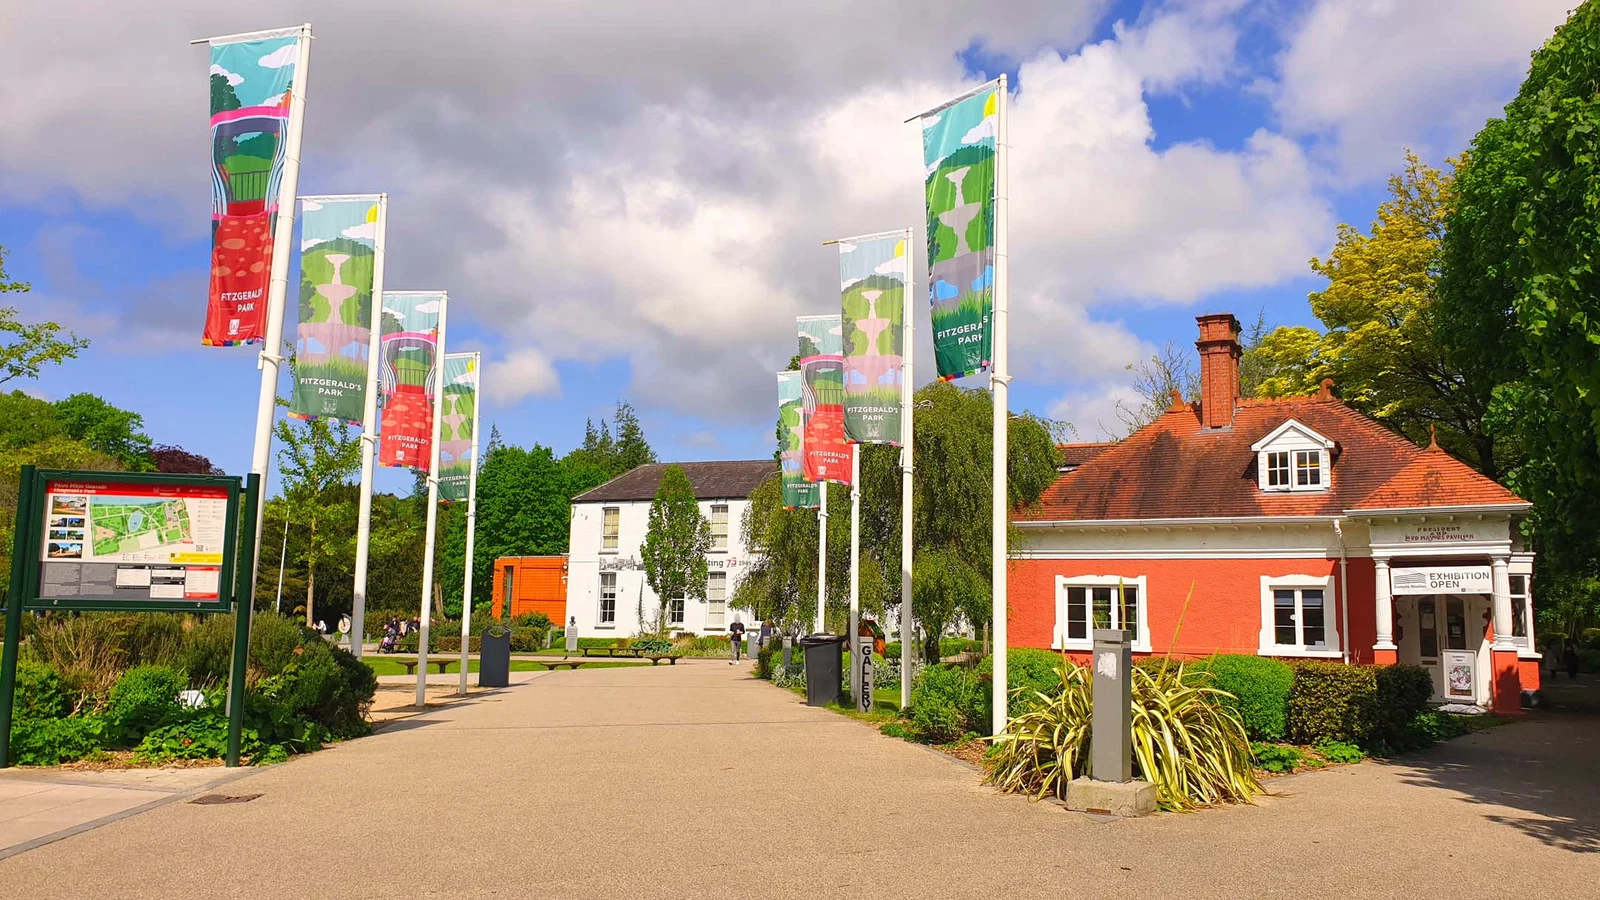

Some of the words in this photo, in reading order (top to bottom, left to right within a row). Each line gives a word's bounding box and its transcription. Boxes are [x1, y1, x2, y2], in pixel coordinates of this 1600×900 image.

[237, 302, 254, 312] PARK
[300, 377, 362, 391] FITZGERALD'S
[318, 387, 343, 397] PARK
[847, 406, 898, 414] FITZGERALD'S
[401, 442, 418, 450] PARK
[809, 451, 849, 460] FITZGERALD'S
[1430, 572, 1490, 580] EXHIBITION
[1430, 580, 1460, 589] OPEN
[862, 646, 872, 713] GALLERY
